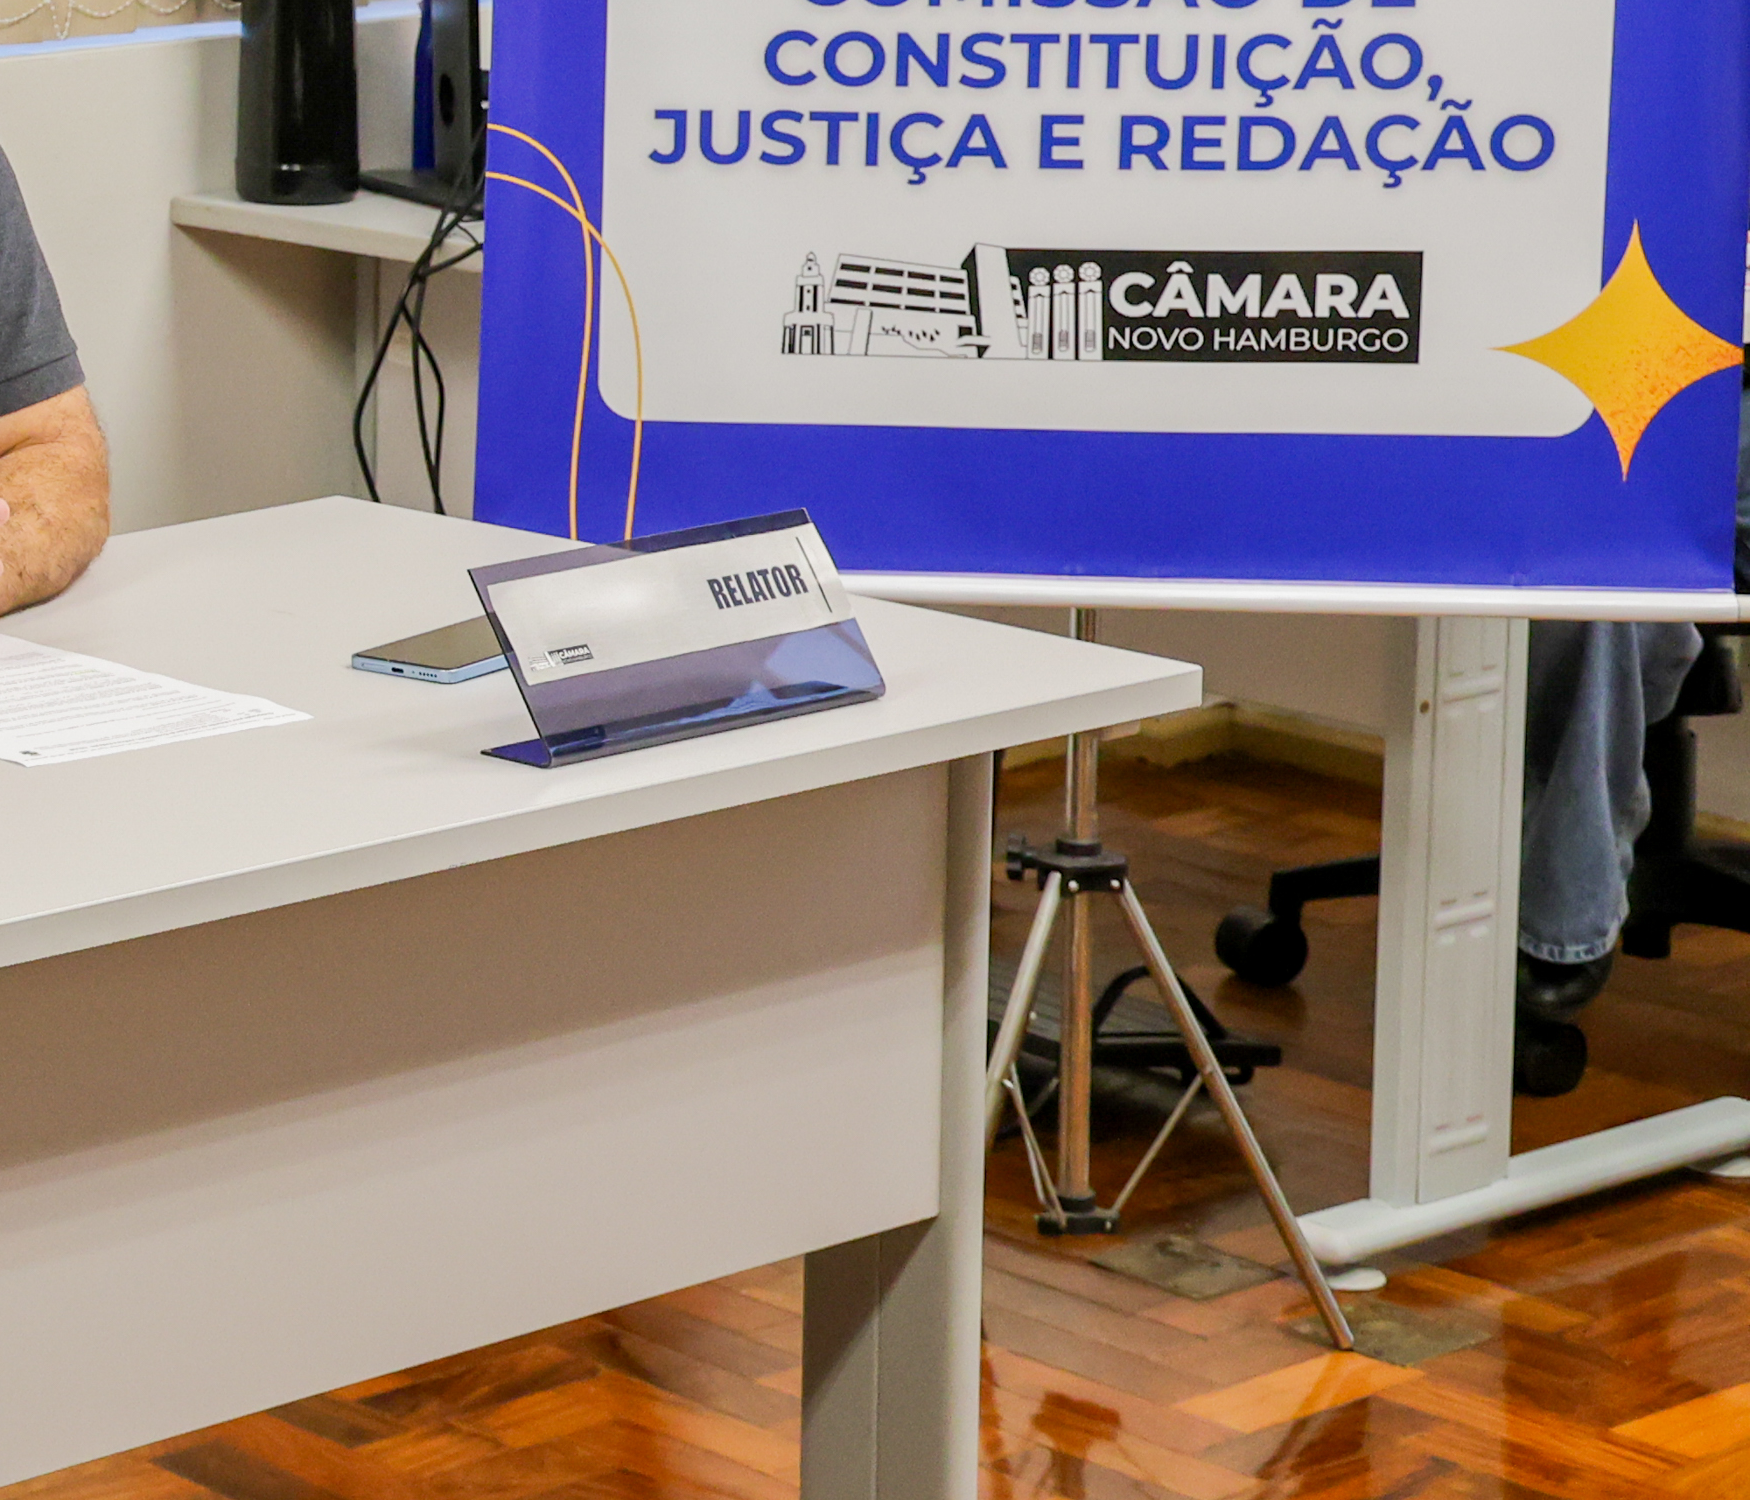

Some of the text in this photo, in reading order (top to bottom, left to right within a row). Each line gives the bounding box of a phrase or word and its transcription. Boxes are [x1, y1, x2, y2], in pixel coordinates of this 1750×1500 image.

[763, 20, 1445, 106] CONSTITUIÇÃO,
[647, 100, 1558, 189] JUSTIÇA E REDAÇÃO
[1107, 261, 1410, 318] CÂMARA
[1107, 325, 1410, 356] NOVO HAMBURGO
[707, 563, 808, 610] RELATOR
